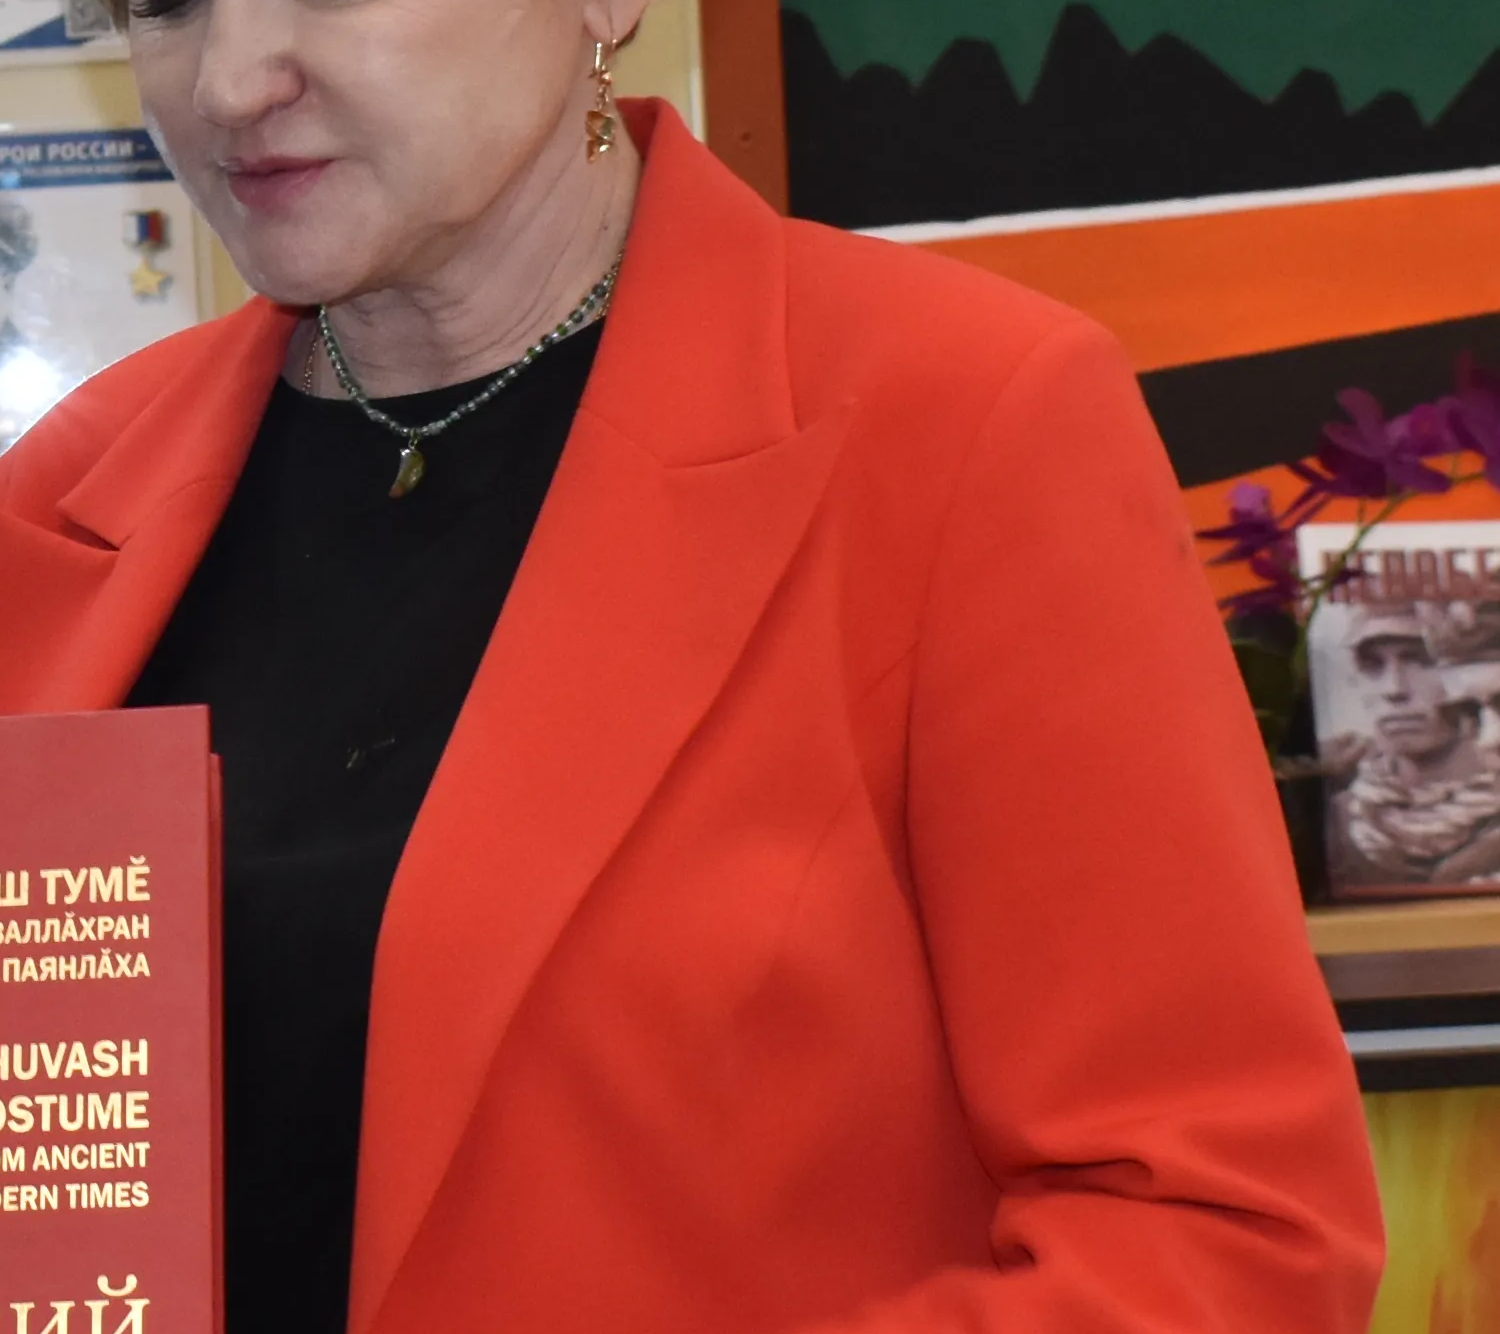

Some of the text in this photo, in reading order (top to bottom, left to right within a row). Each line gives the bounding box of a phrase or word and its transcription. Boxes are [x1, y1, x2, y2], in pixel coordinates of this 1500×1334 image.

[46, 140, 134, 161] РОССИИ
[31, 1142, 150, 1171] ANCIENT
[65, 1180, 150, 1209] TIMES
